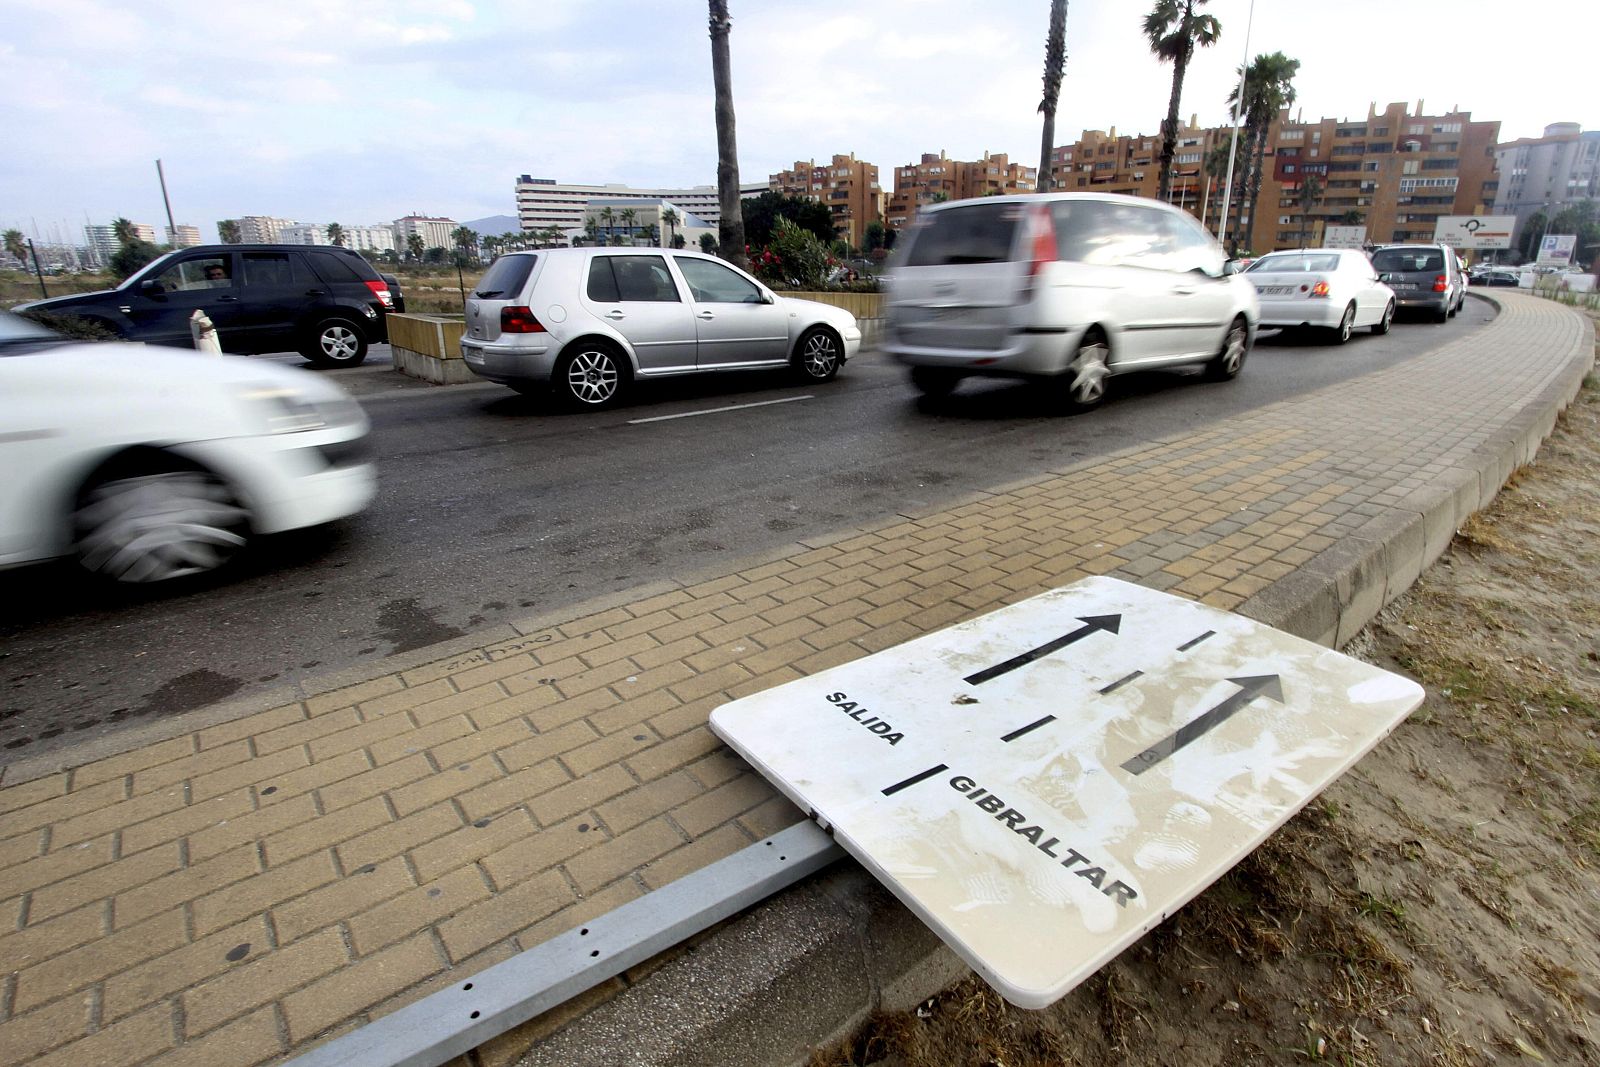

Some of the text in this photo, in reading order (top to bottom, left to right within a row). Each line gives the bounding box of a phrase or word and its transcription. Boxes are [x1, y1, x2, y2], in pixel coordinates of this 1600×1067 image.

[1544, 238, 1556, 249] P
[825, 691, 905, 747] SALIDA
[949, 775, 1138, 908] GIBRALTAR
